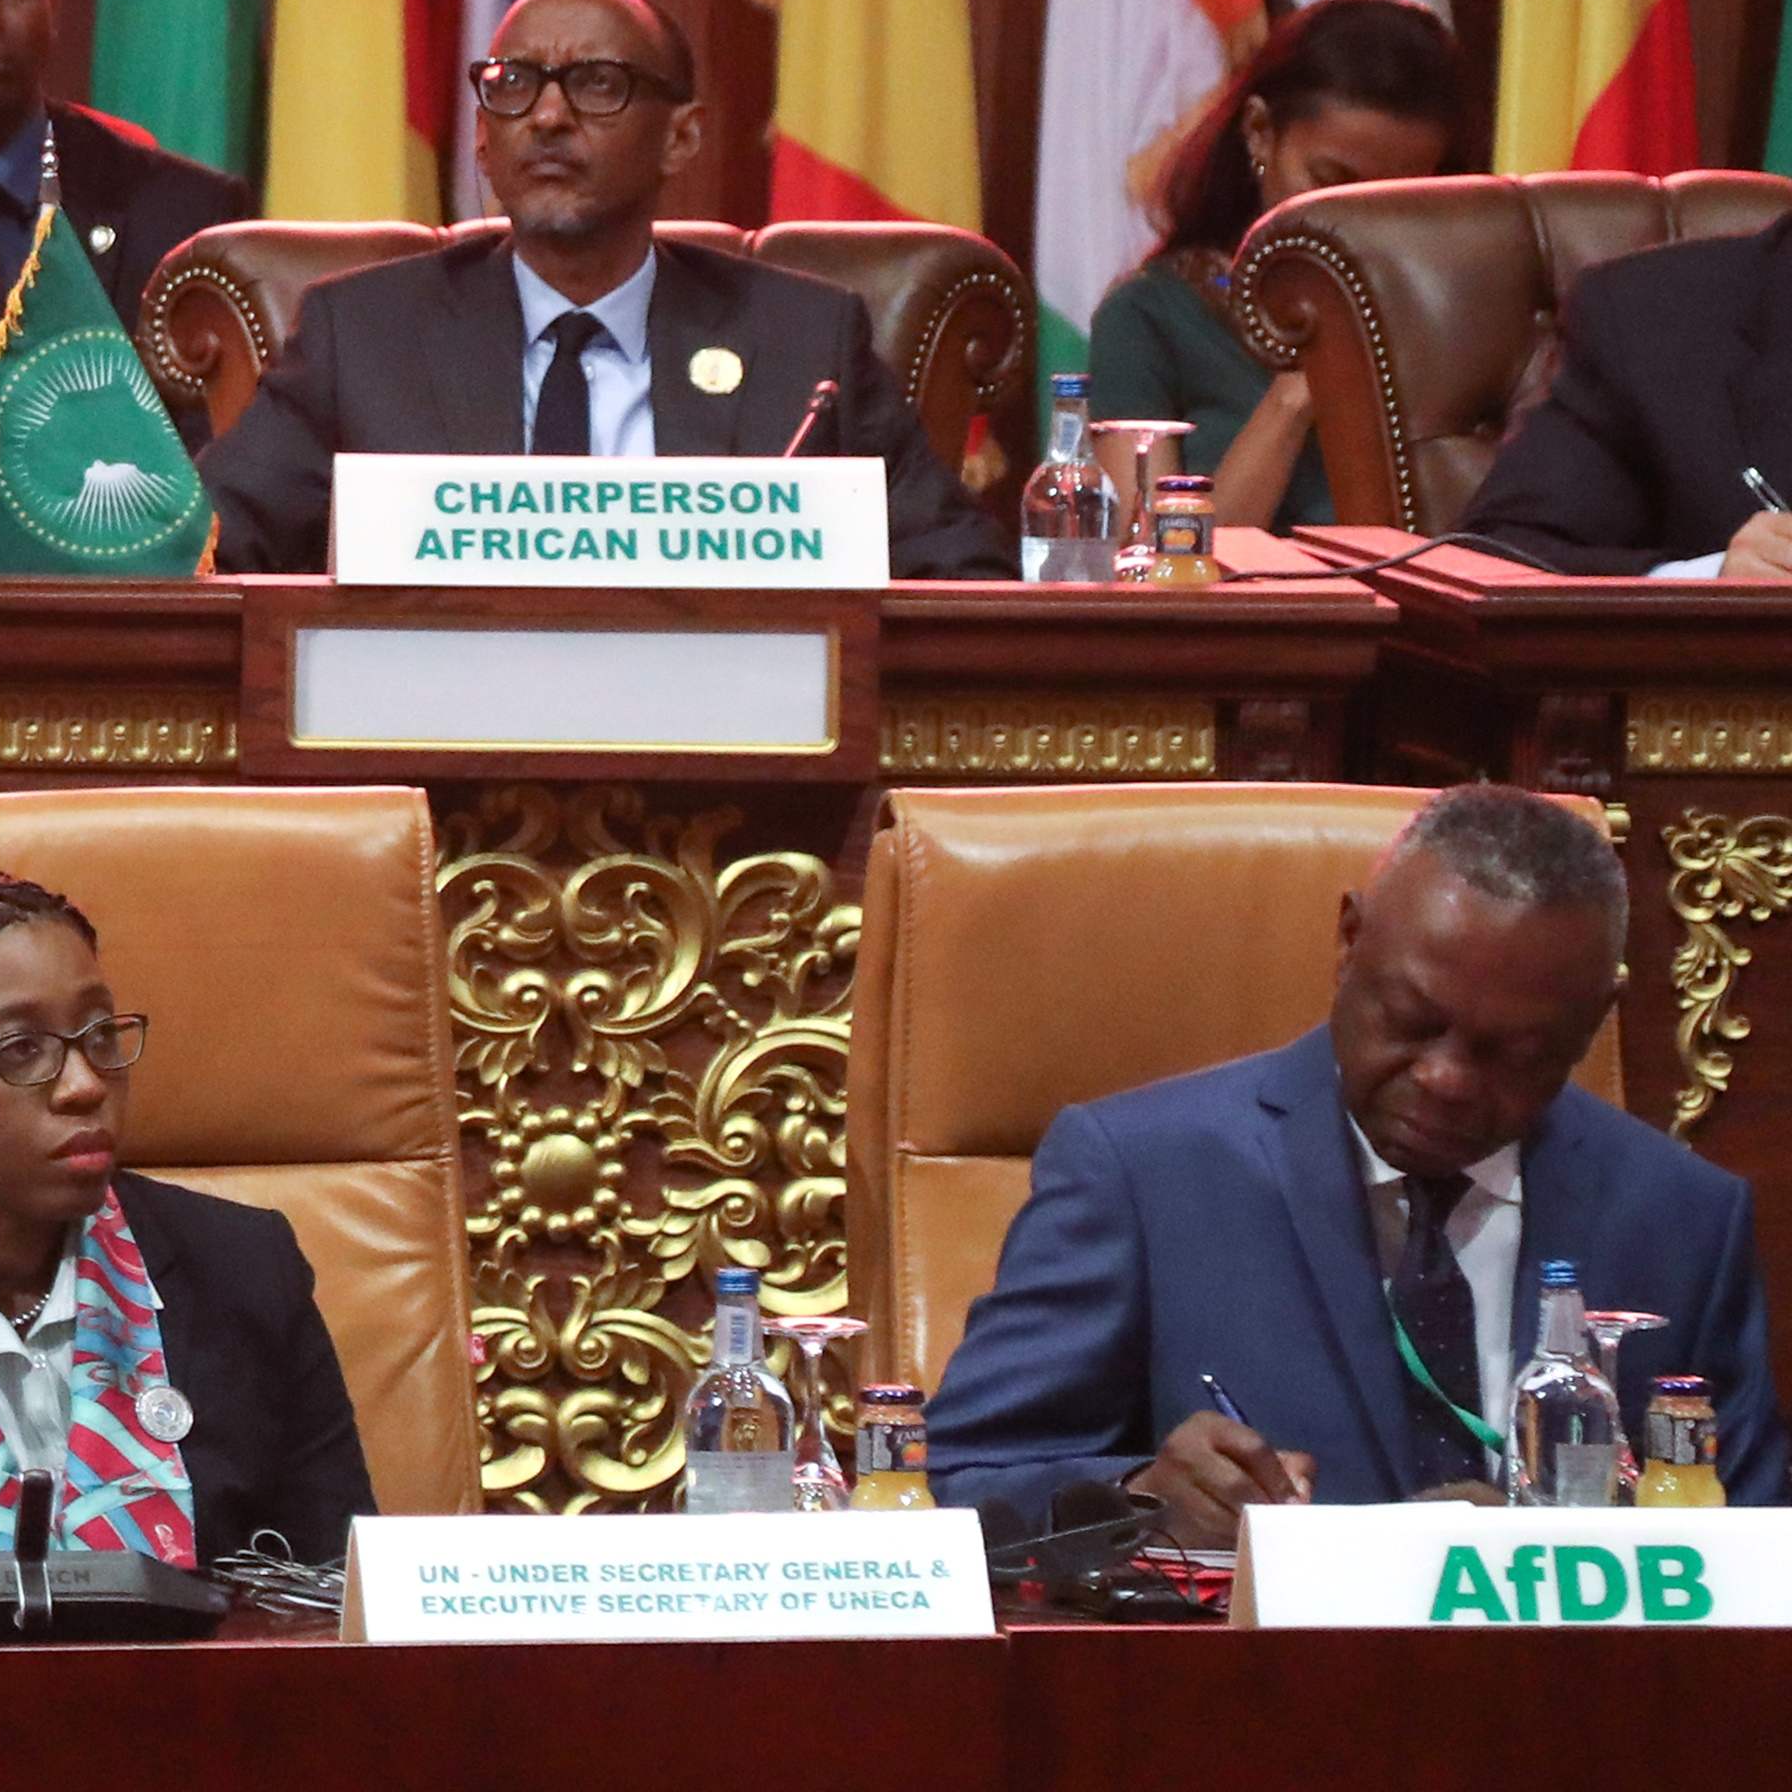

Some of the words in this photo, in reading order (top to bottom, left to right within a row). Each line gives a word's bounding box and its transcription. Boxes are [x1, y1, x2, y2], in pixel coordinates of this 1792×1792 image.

[433, 481, 801, 515] CHAIRPERSON
[415, 528, 638, 561] AFRICAN
[658, 527, 824, 561] UNION
[419, 1564, 460, 1584] UN
[487, 1563, 590, 1584] UNDER
[599, 1562, 770, 1584] SECRETARY
[782, 1560, 921, 1581] GENERAL
[931, 1559, 951, 1579] &
[1428, 1544, 1715, 1621] AfDB
[421, 1594, 589, 1614] EXECUTIVE
[598, 1592, 769, 1613] SECRETARY
[780, 1592, 817, 1611] OF
[828, 1590, 931, 1610] UNECA
